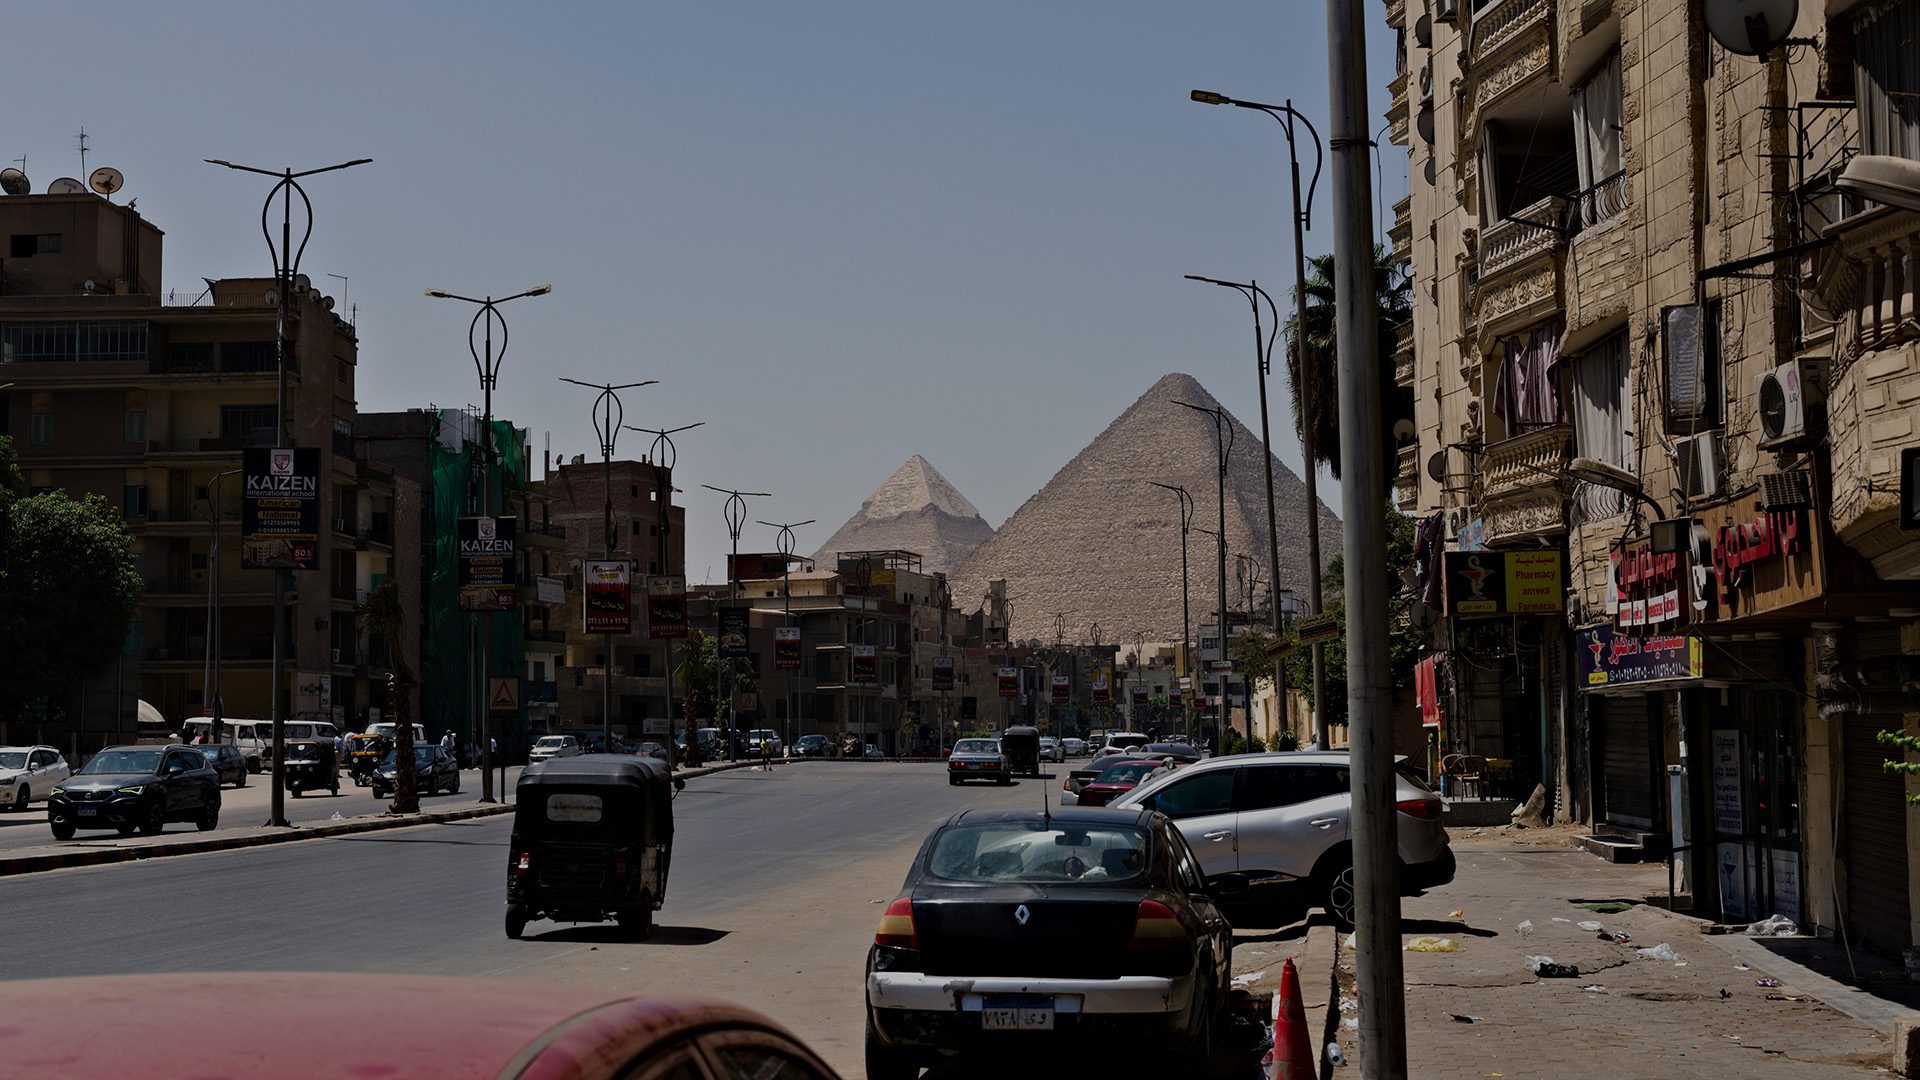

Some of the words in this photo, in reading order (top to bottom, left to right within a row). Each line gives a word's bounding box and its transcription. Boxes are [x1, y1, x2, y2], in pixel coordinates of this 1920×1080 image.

[1789, 393, 1798, 403] LG
[247, 475, 316, 491] KAIZEN
[259, 499, 301, 507] American
[262, 511, 299, 519] National
[460, 539, 514, 552] KAIZEN
[1515, 554, 1556, 566] صيدلية
[1515, 569, 1556, 580] Pharmacy
[1518, 601, 1556, 611] Farmacia
